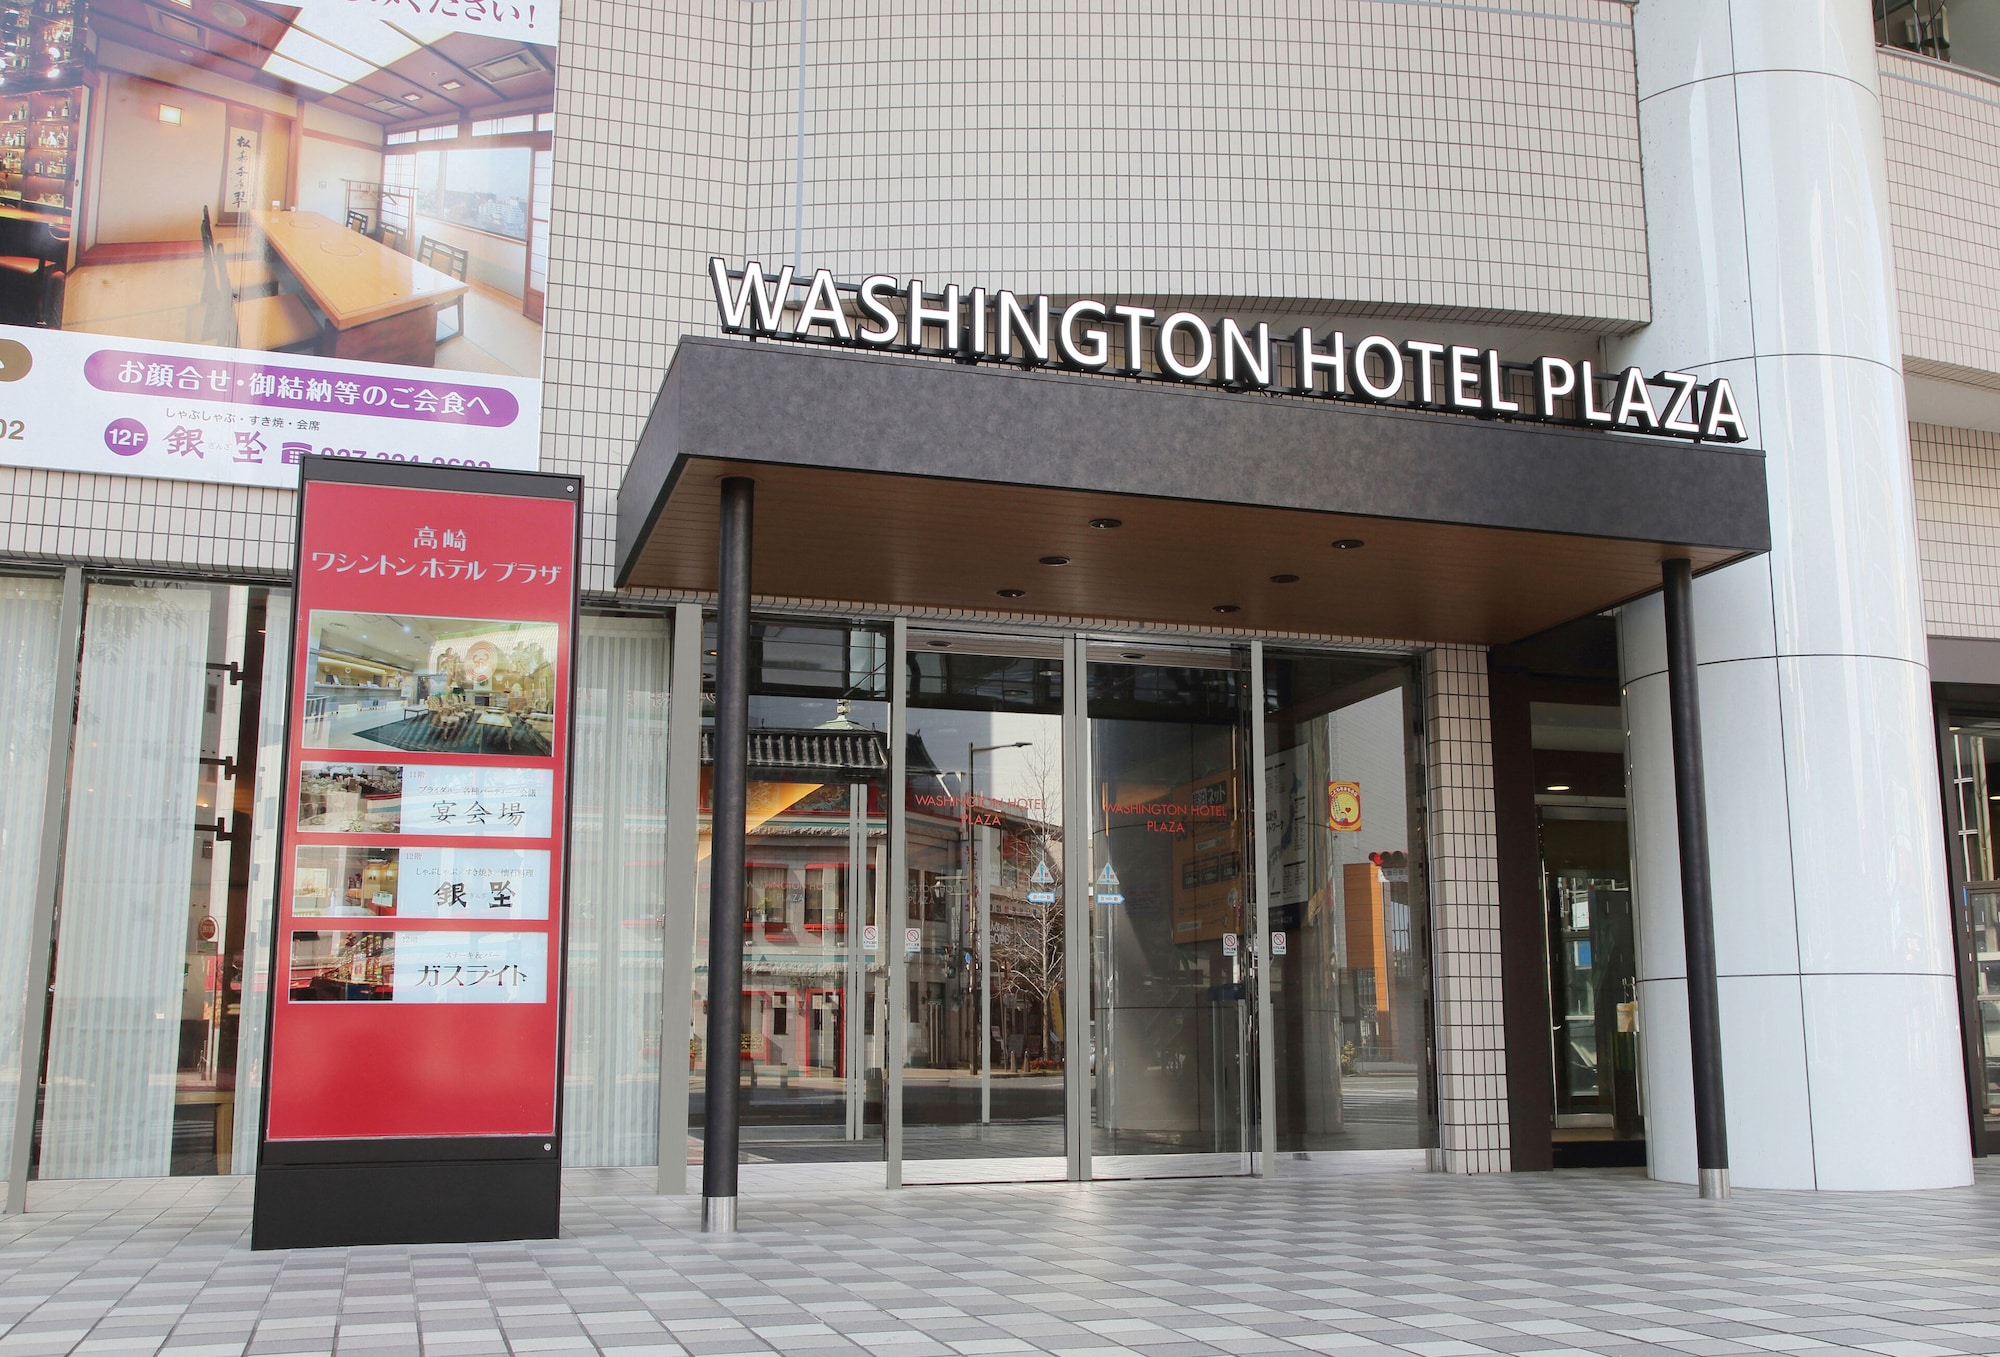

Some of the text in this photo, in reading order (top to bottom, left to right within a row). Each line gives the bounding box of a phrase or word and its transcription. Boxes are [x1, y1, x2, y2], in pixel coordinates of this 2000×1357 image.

[709, 256, 1749, 444] WASHINGTON HOTEL PLAZA
[117, 360, 491, 416] お顔合せ・御結納等のご会食へ
[165, 406, 321, 432] しゃぶしゃぶ・すき焼・会席
[108, 428, 145, 447] 12F
[413, 525, 467, 552] 高崎
[430, 800, 526, 827] 宴会場
[915, 794, 1047, 810] WASHINGTON HOTEL
[1105, 803, 1227, 817] WASHINGTON HOTEL
[961, 813, 1001, 826] PLAZA
[1146, 821, 1184, 833] PLAZA
[415, 964, 527, 987] ガスライト
